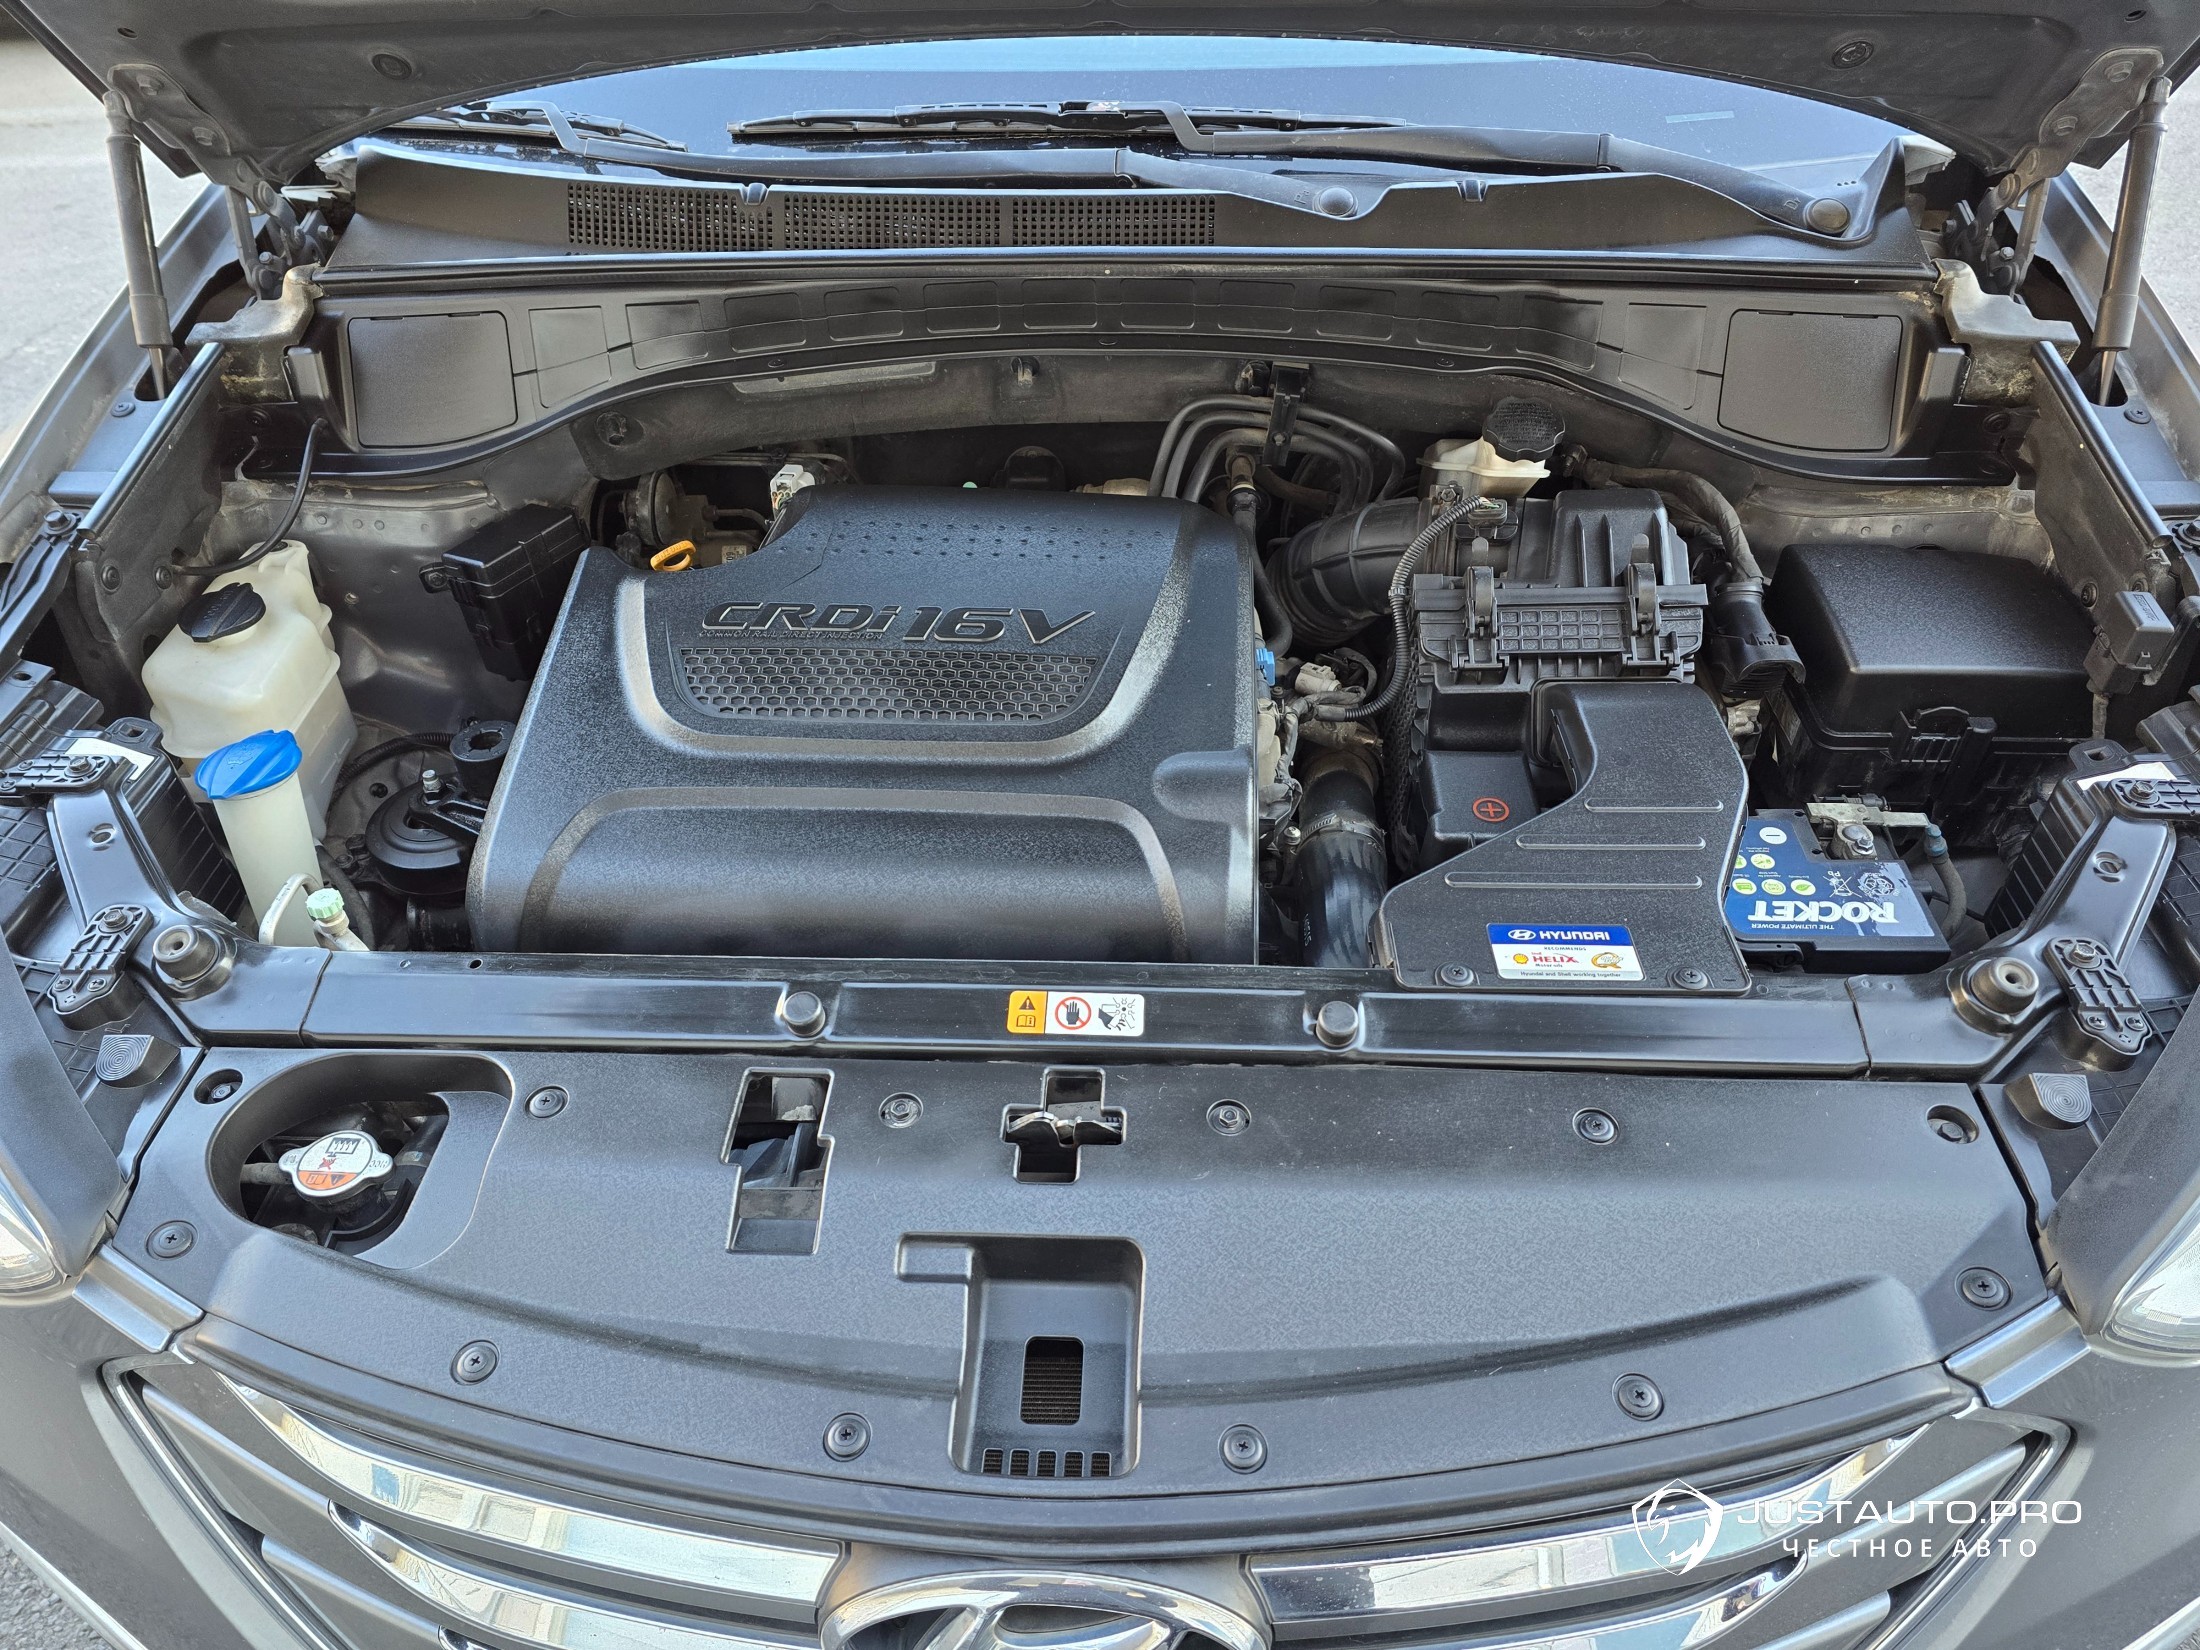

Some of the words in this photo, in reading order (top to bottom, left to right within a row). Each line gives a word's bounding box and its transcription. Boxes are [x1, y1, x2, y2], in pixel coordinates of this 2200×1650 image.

[701, 601, 902, 633] CRDi
[699, 630, 751, 638] COMMON
[752, 630, 777, 638] RAIL
[779, 631, 821, 639] DIRECT
[822, 631, 883, 640] INJECTION
[1827, 870, 1841, 878] Pb
[1747, 900, 1899, 923] ROCKET
[1540, 931, 1610, 941] HYUNDAI
[1532, 955, 1579, 963] HELIX
